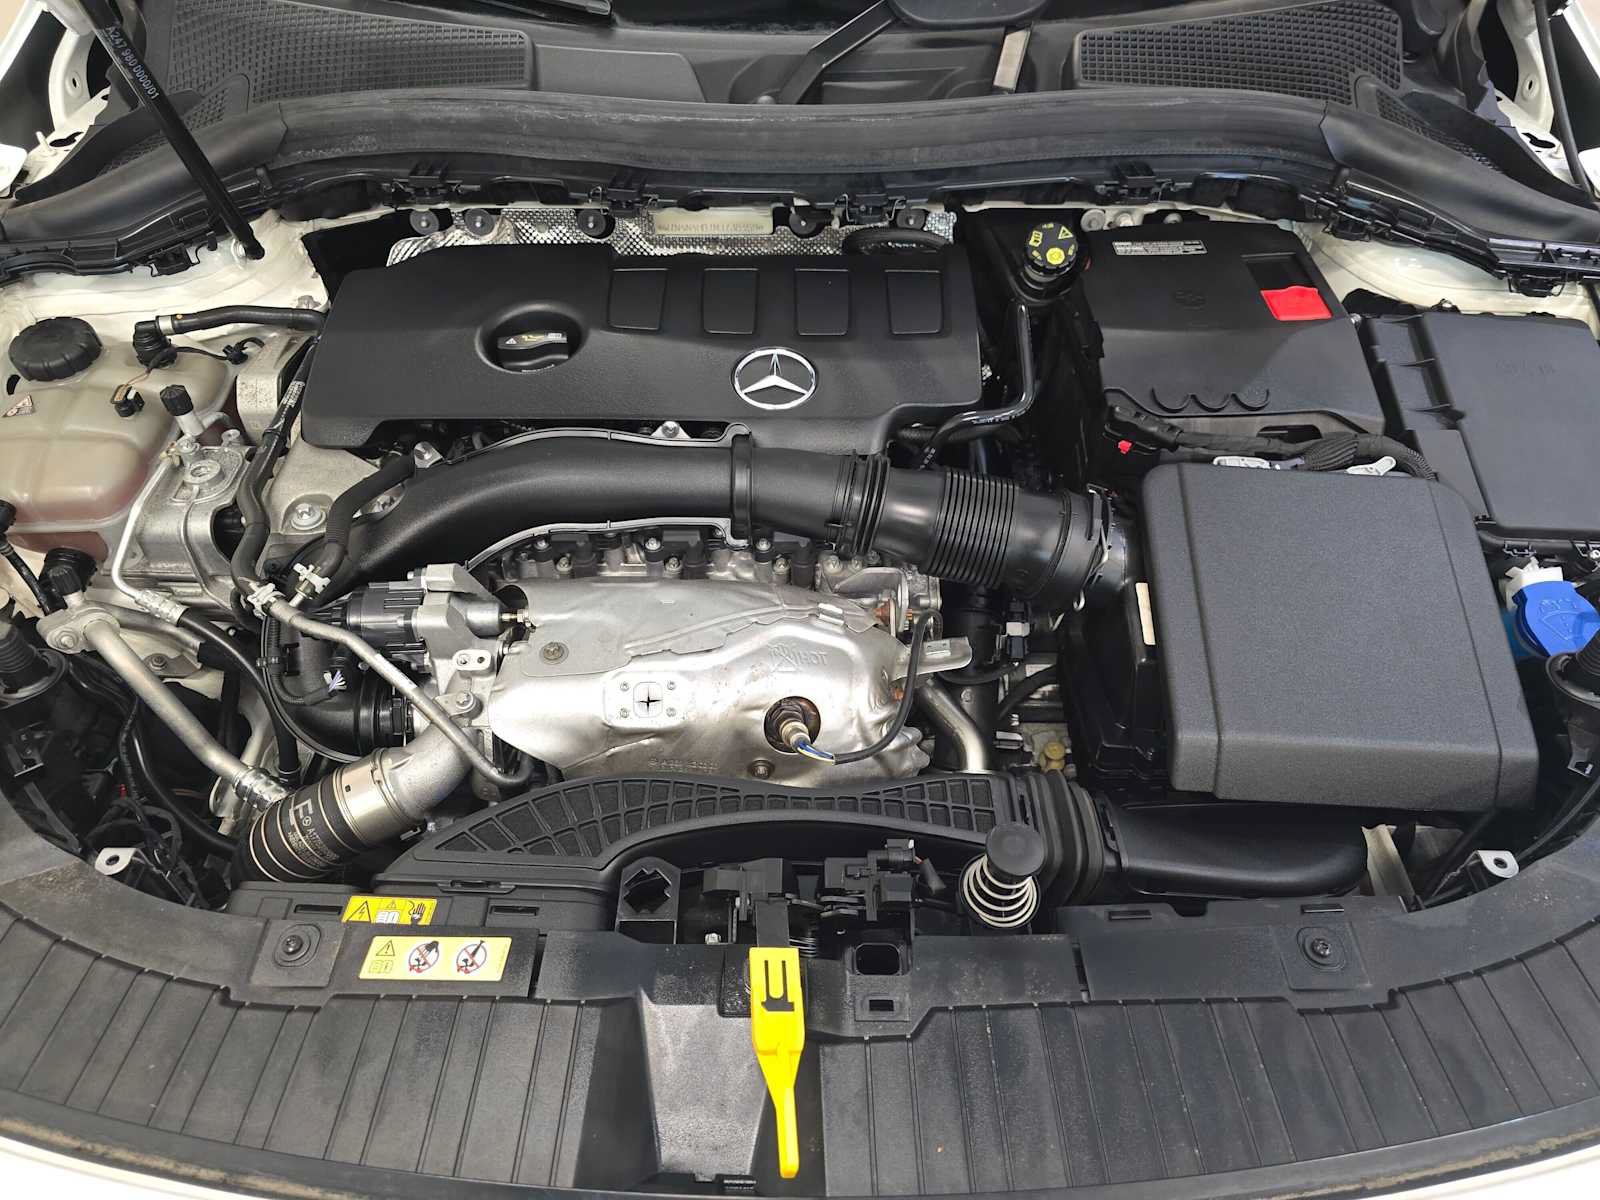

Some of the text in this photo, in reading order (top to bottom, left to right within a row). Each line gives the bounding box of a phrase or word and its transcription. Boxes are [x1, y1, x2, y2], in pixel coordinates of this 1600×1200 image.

[105, 26, 160, 99] A247 980 0000/01
